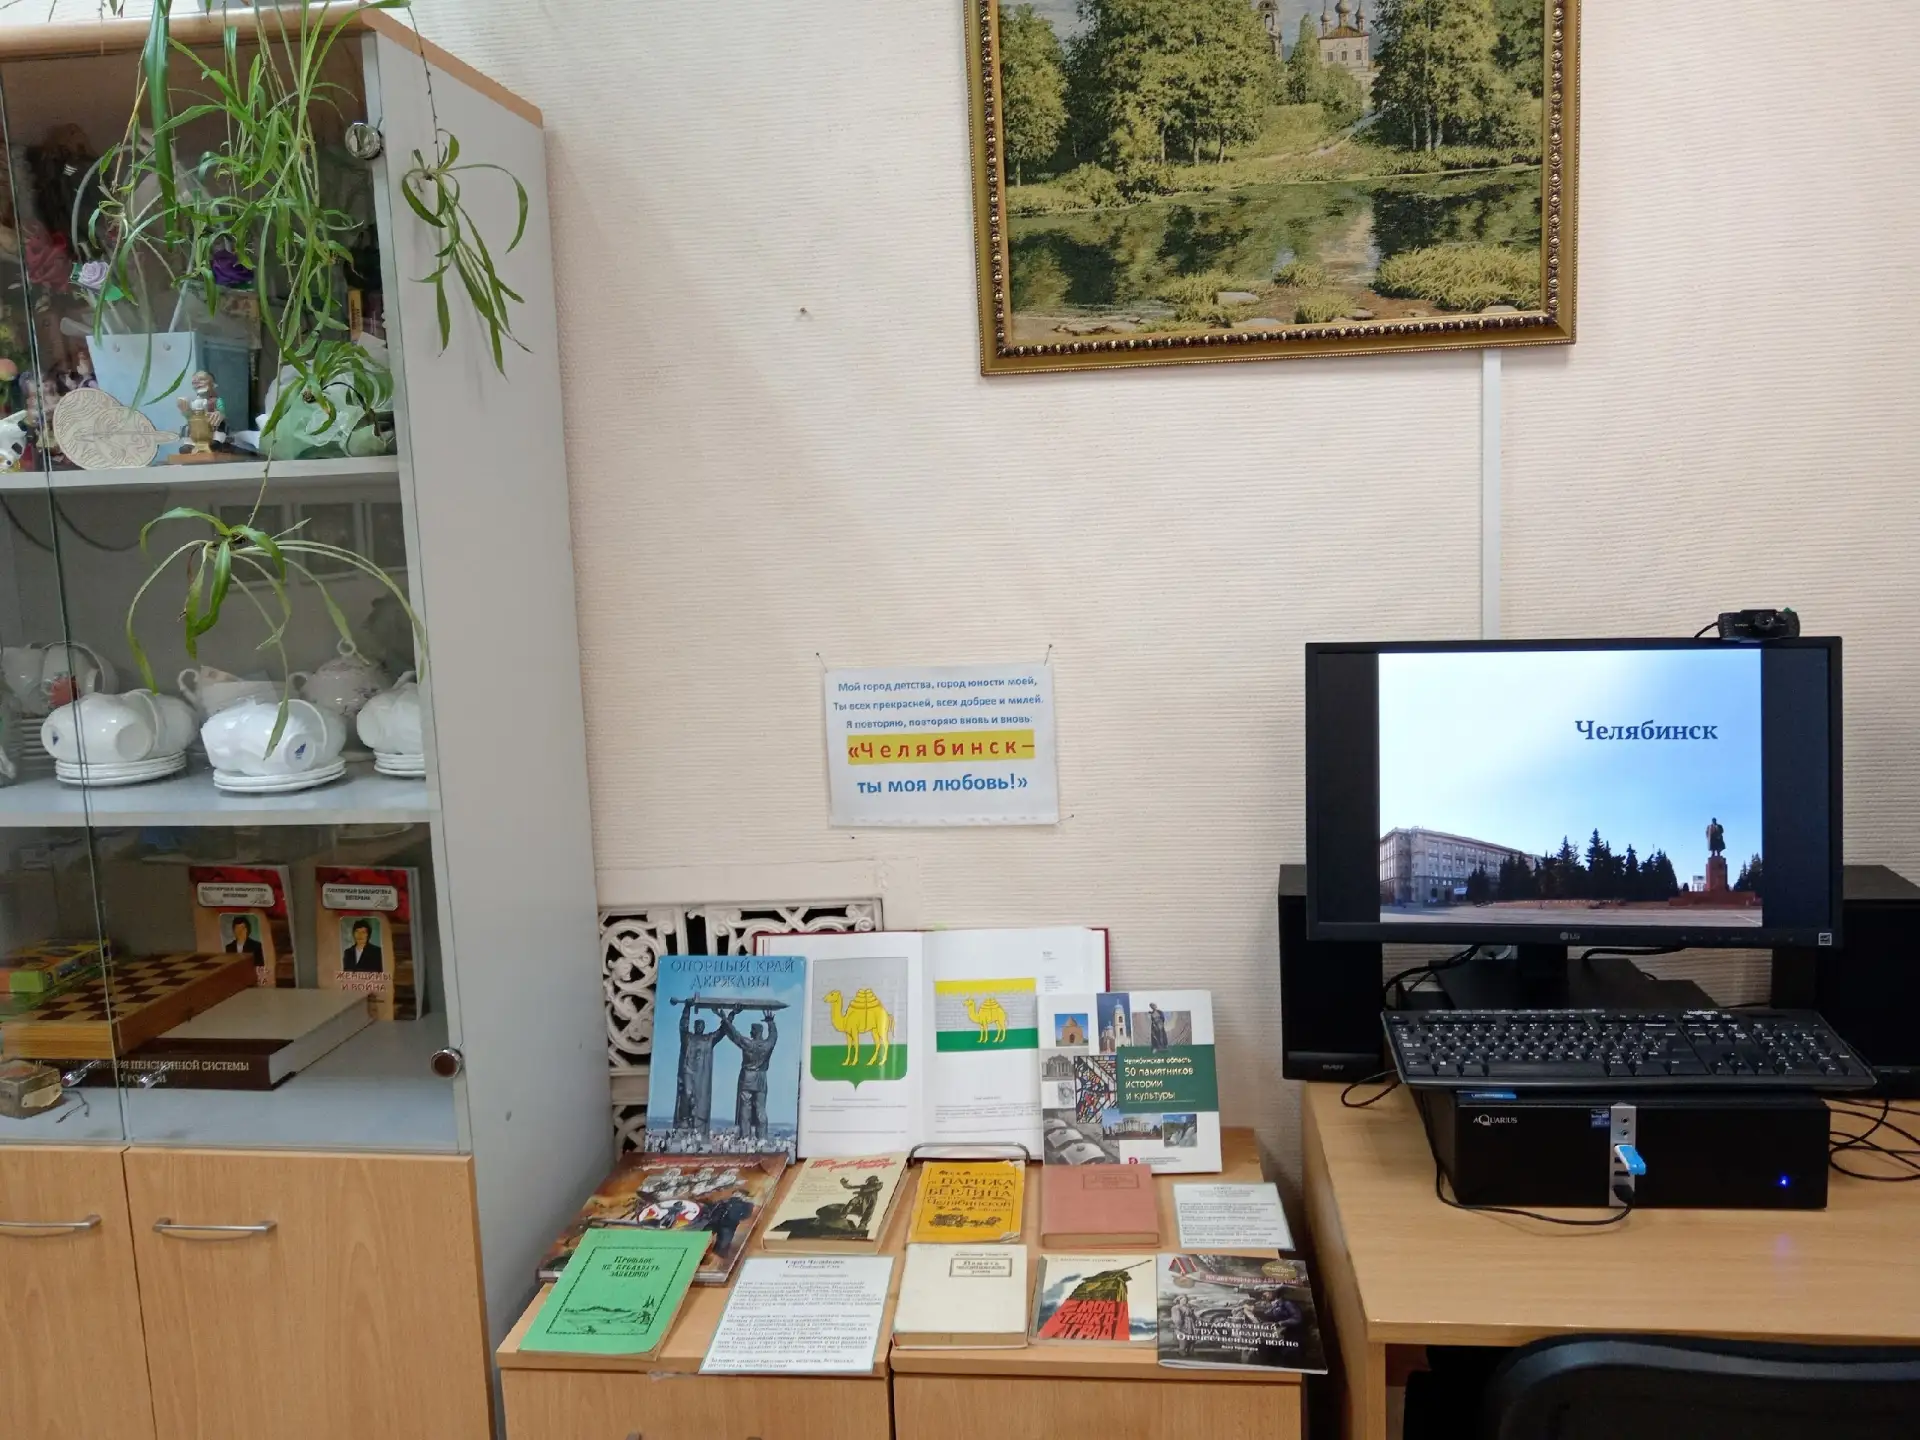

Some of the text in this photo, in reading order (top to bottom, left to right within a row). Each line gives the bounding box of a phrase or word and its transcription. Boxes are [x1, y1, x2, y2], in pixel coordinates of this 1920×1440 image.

[838, 676, 1038, 693] Мой город детства, город юности моей,
[834, 702, 847, 711] Ты
[873, 699, 934, 712] прекрасней,
[936, 699, 958, 708] всех
[960, 697, 997, 708] добрее
[999, 697, 1006, 705] и
[846, 714, 1033, 730] Я повторяю, повторяю вновь и вновь:
[1574, 719, 1719, 741] Челябинск
[857, 773, 1028, 794] ты моя любовь!»
[669, 957, 796, 973] ОПОРНЫЙ КРАЙ
[336, 972, 392, 981] ЖЕНЩИНЫ
[351, 982, 387, 992] ВОЙНА
[690, 975, 770, 990] ДЕРЖАВЫ
[1123, 1056, 1192, 1065] Челябинская область
[201, 1061, 250, 1071] СИСТЕМЫ
[1124, 1067, 1194, 1077] 50 памятников
[1125, 1080, 1164, 1089] истории
[1134, 1092, 1176, 1102] культуры
[1472, 1114, 1518, 1126] AQUARIUS
[941, 1178, 1013, 1186] ПАРИЖА
[928, 1188, 1012, 1197] БЕРЛИНА
[1210, 1321, 1278, 1331] доблестный
[1231, 1328, 1279, 1339] Великой
[1176, 1334, 1262, 1345] Отечественной
[1265, 1339, 1299, 1348] войне
